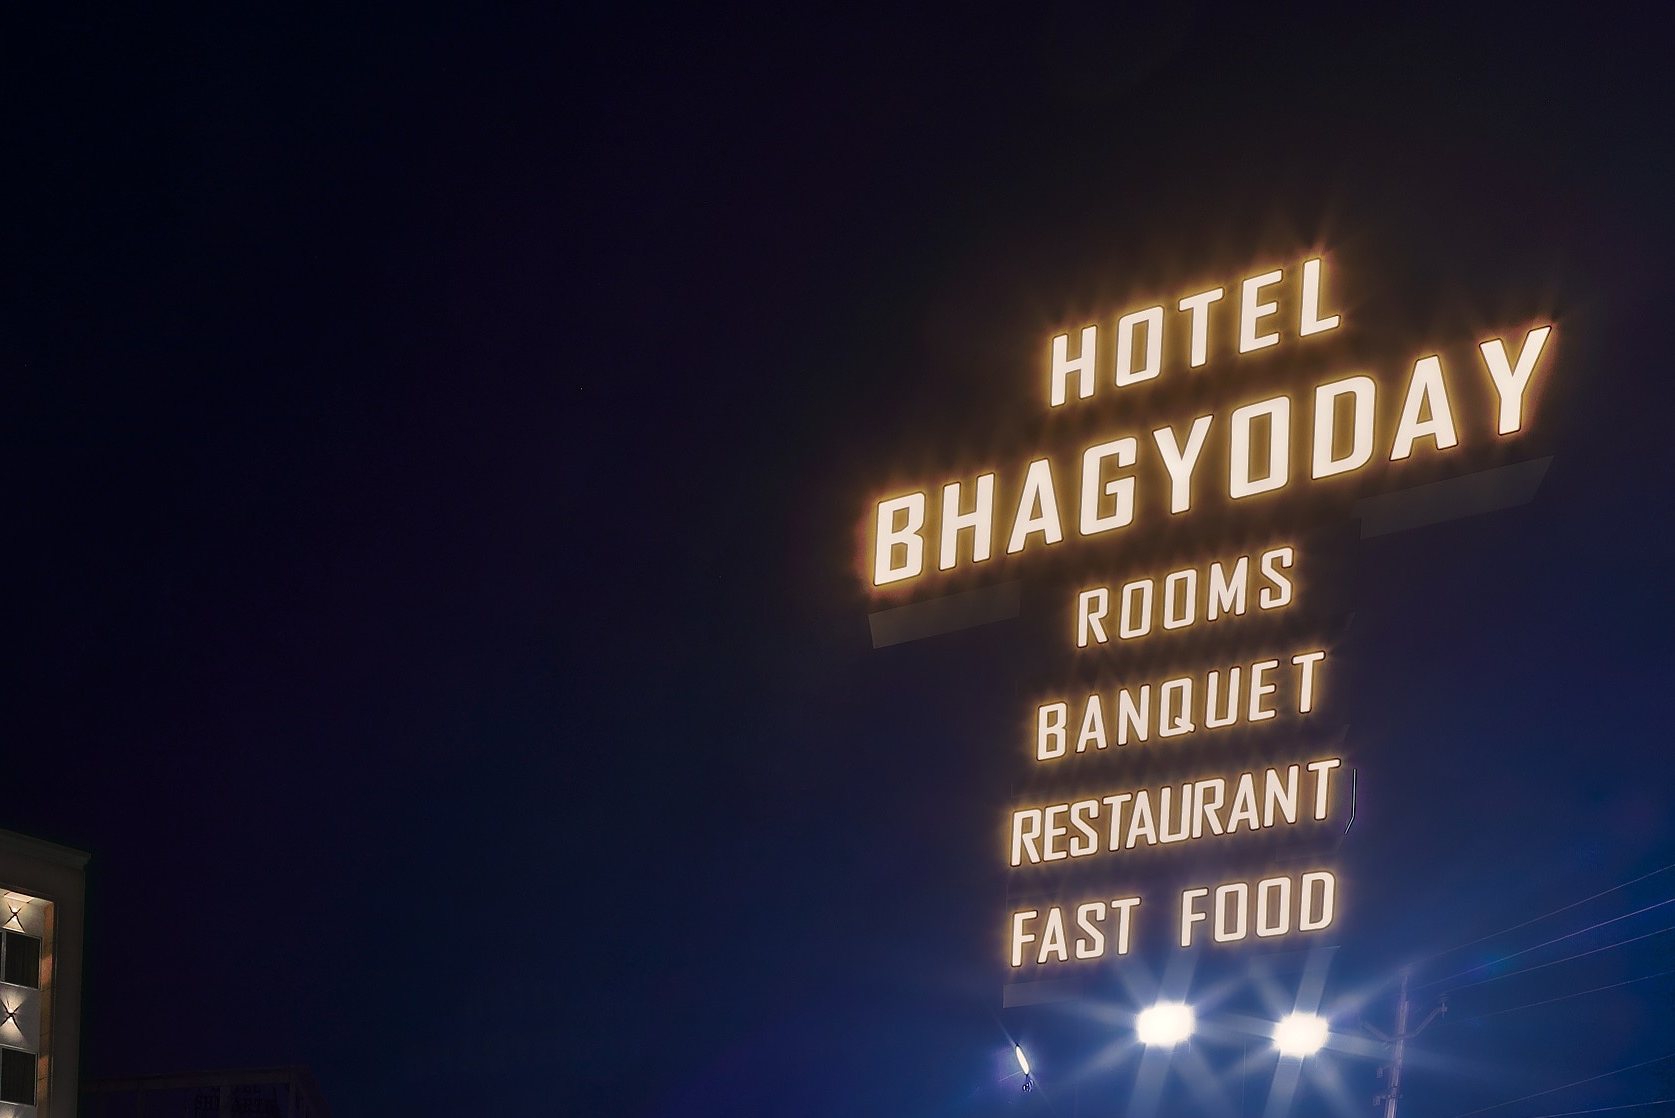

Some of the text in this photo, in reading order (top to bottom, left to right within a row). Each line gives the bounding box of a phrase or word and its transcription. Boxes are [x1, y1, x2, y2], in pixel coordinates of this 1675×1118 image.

[1049, 257, 1341, 407] HOTEL
[873, 325, 1552, 586] BHAGYODAY
[1076, 546, 1295, 649] ROOMS
[1035, 650, 1326, 762] BANQUET
[1009, 757, 1341, 868] RESTAURANT
[1010, 870, 1336, 968] FAST FOOD
